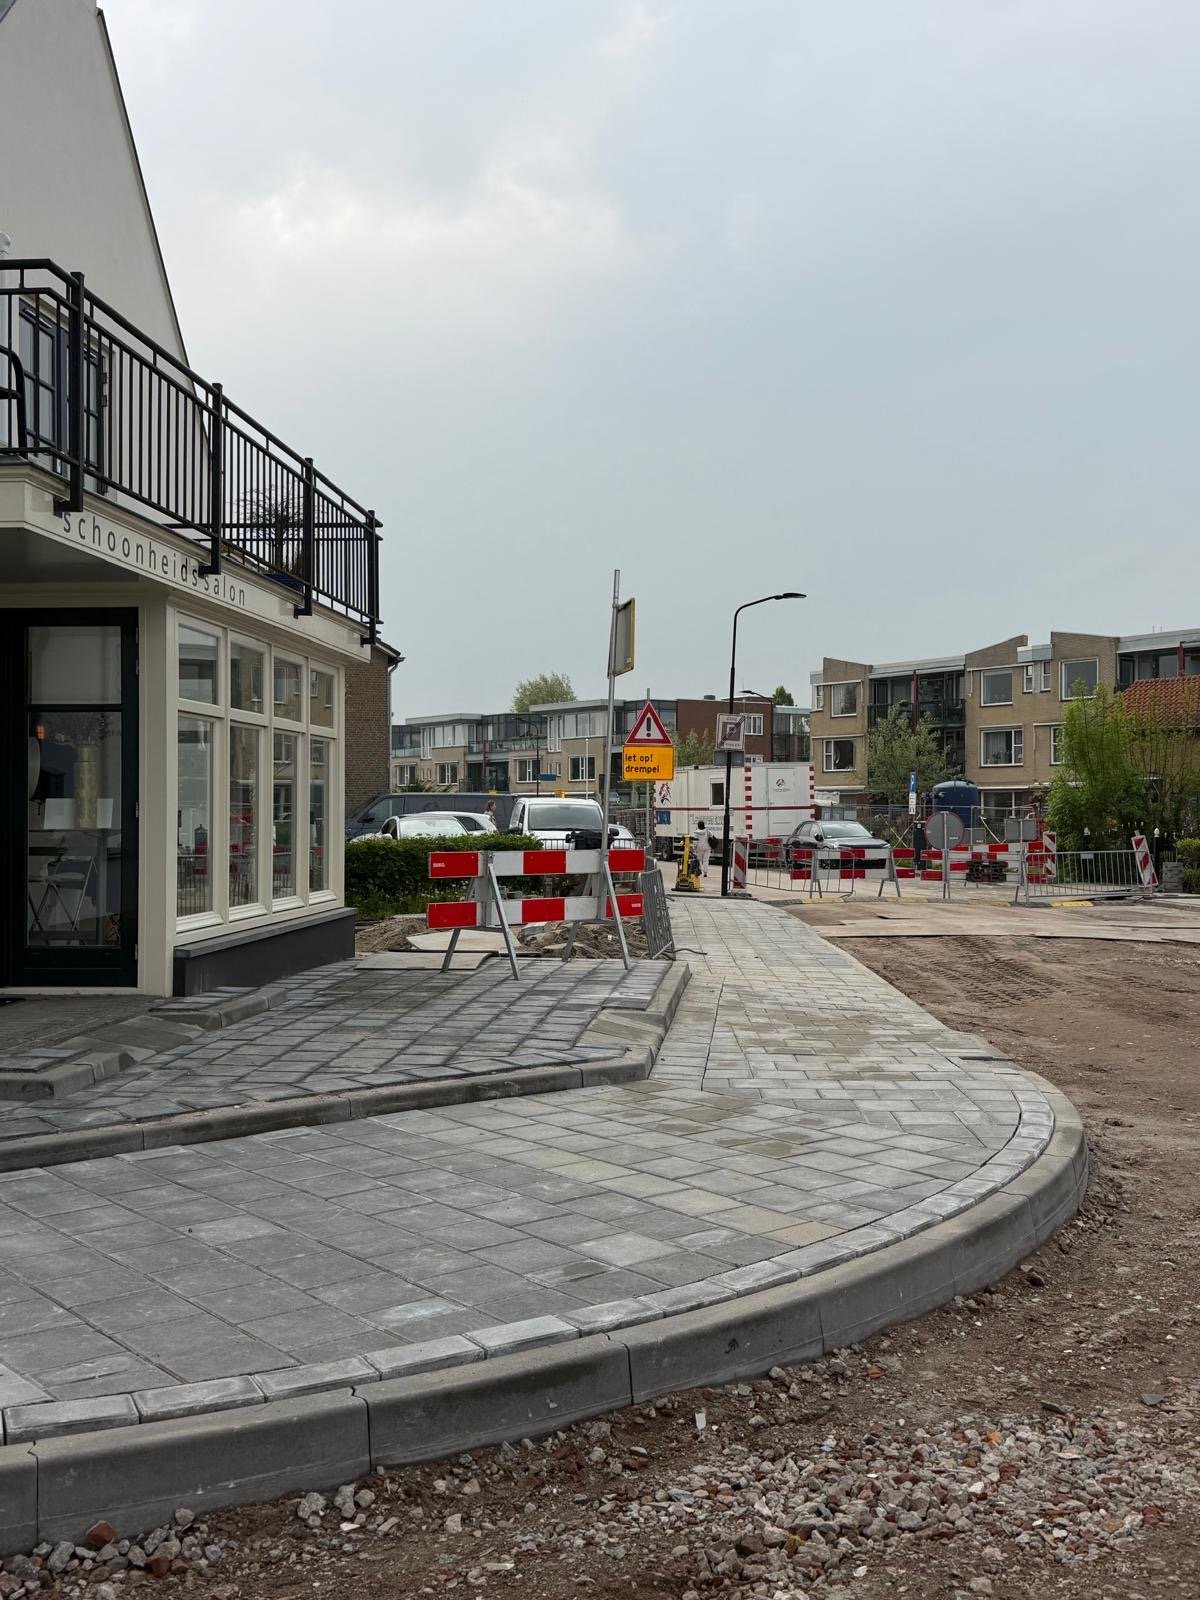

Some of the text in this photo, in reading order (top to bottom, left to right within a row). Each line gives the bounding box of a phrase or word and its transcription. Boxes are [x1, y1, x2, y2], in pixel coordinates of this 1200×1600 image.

[63, 512, 245, 606] schoonheidssalon
[625, 753, 653, 764] let op!
[625, 765, 660, 774] drempel
